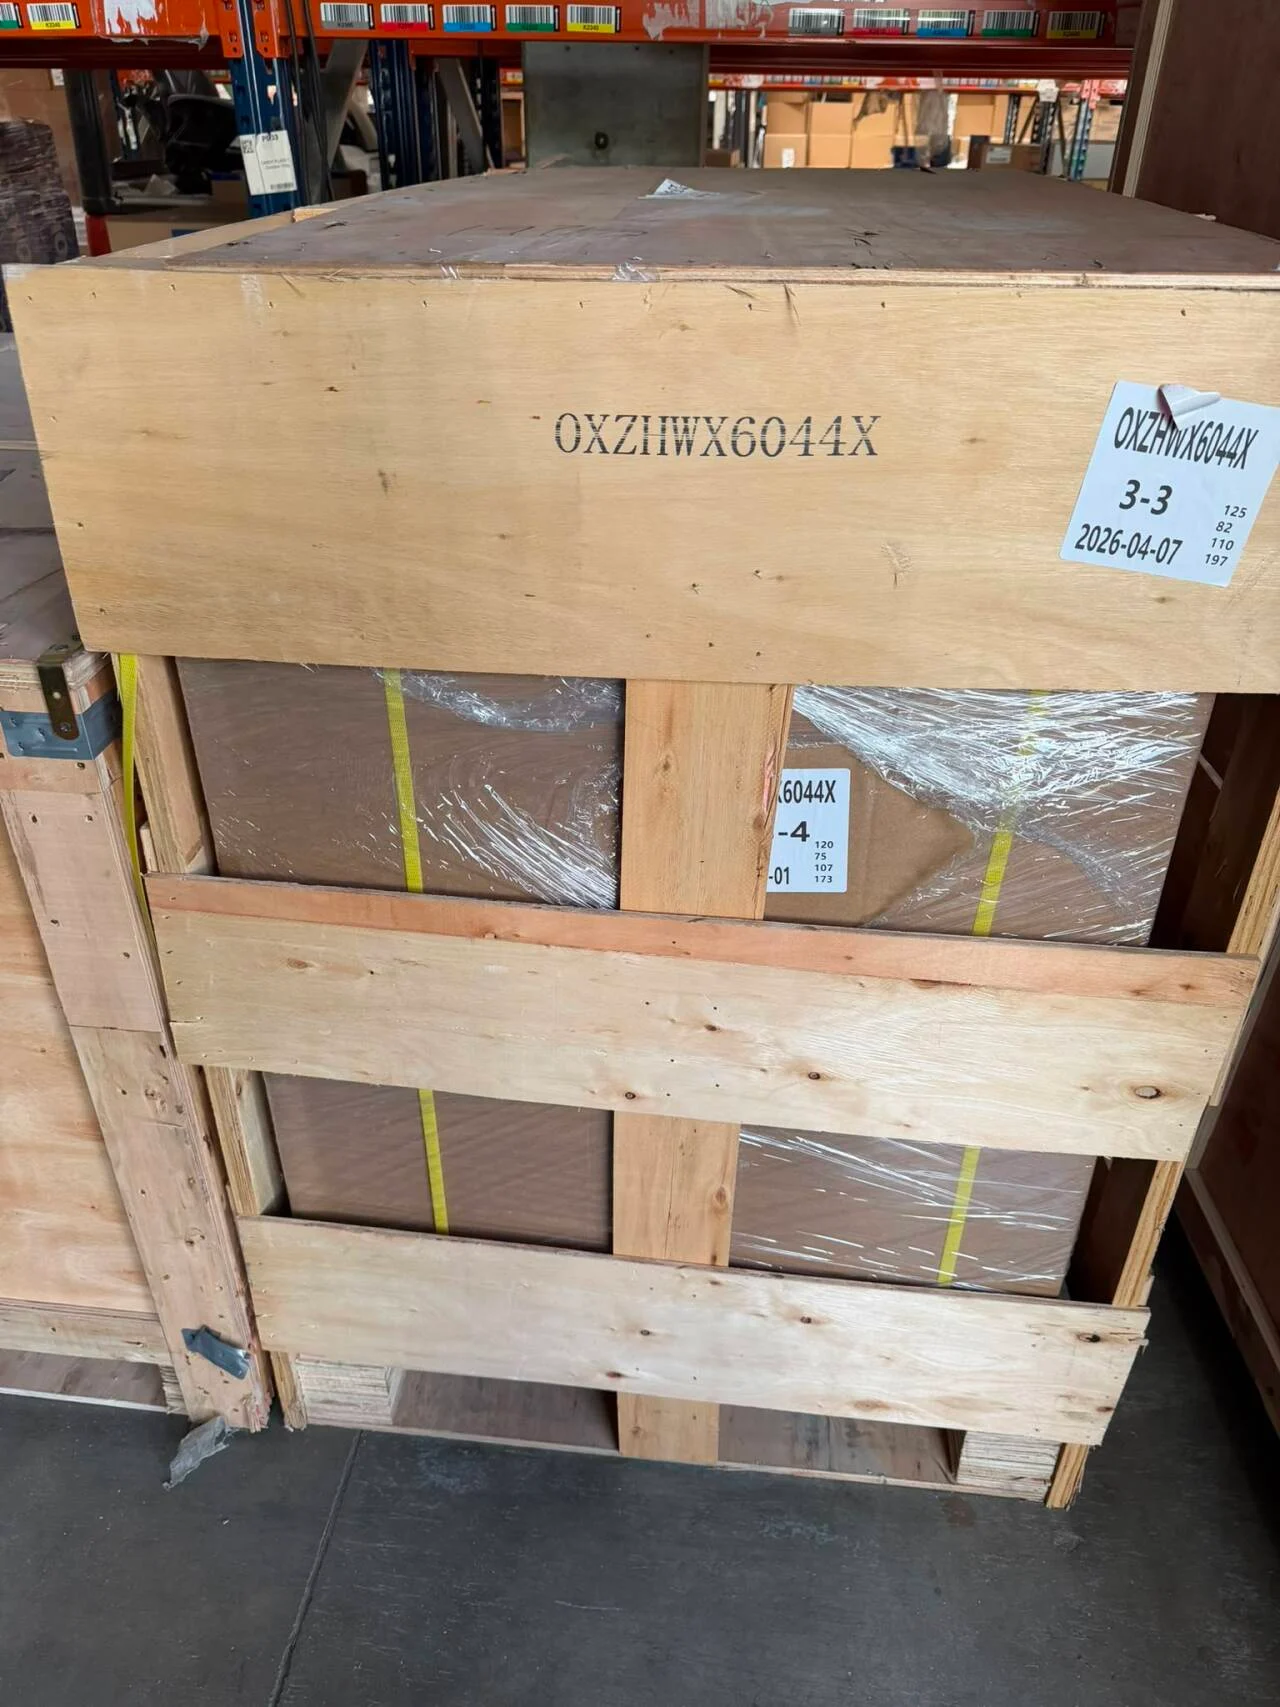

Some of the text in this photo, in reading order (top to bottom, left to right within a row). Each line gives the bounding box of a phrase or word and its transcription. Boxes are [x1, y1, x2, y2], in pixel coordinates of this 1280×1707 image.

[554, 412, 882, 458] OXZHWX6044X
[1118, 479, 1174, 516] 3-3
[1223, 504, 1248, 519] 125
[1215, 521, 1234, 534] 82
[1074, 523, 1184, 566] 2026-04-07
[1210, 537, 1235, 551] 110
[1203, 553, 1229, 568] 197
[815, 840, 834, 849] 120
[814, 852, 827, 861] 75
[814, 863, 834, 872] 107
[814, 875, 833, 883] 173
